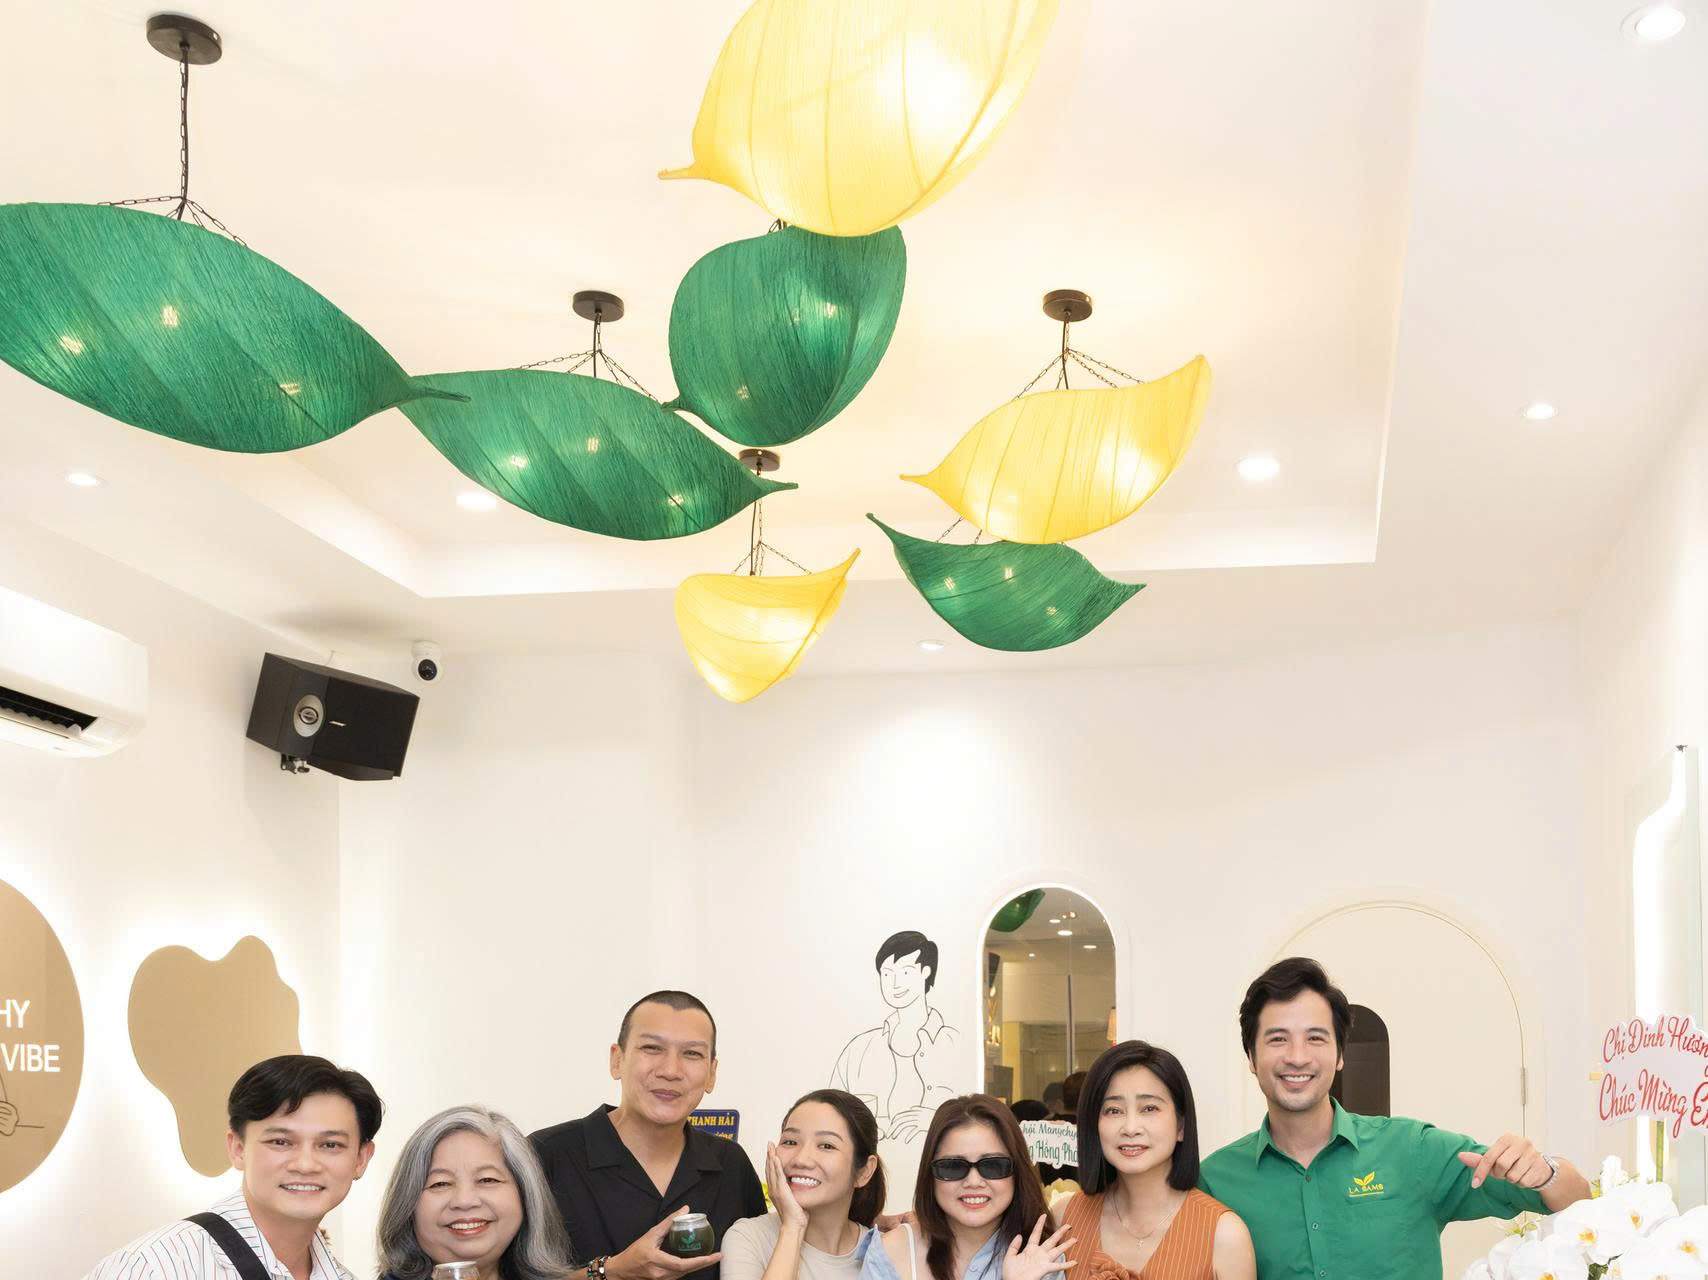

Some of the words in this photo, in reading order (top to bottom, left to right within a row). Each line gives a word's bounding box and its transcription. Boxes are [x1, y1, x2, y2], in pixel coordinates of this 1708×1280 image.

[0, 1043, 61, 1072] VIBE
[1603, 1025, 1626, 1063] Chị
[1599, 1073, 1636, 1120] Chúc
[1638, 1068, 1688, 1139] Mừng
[1691, 1081, 1708, 1129] E
